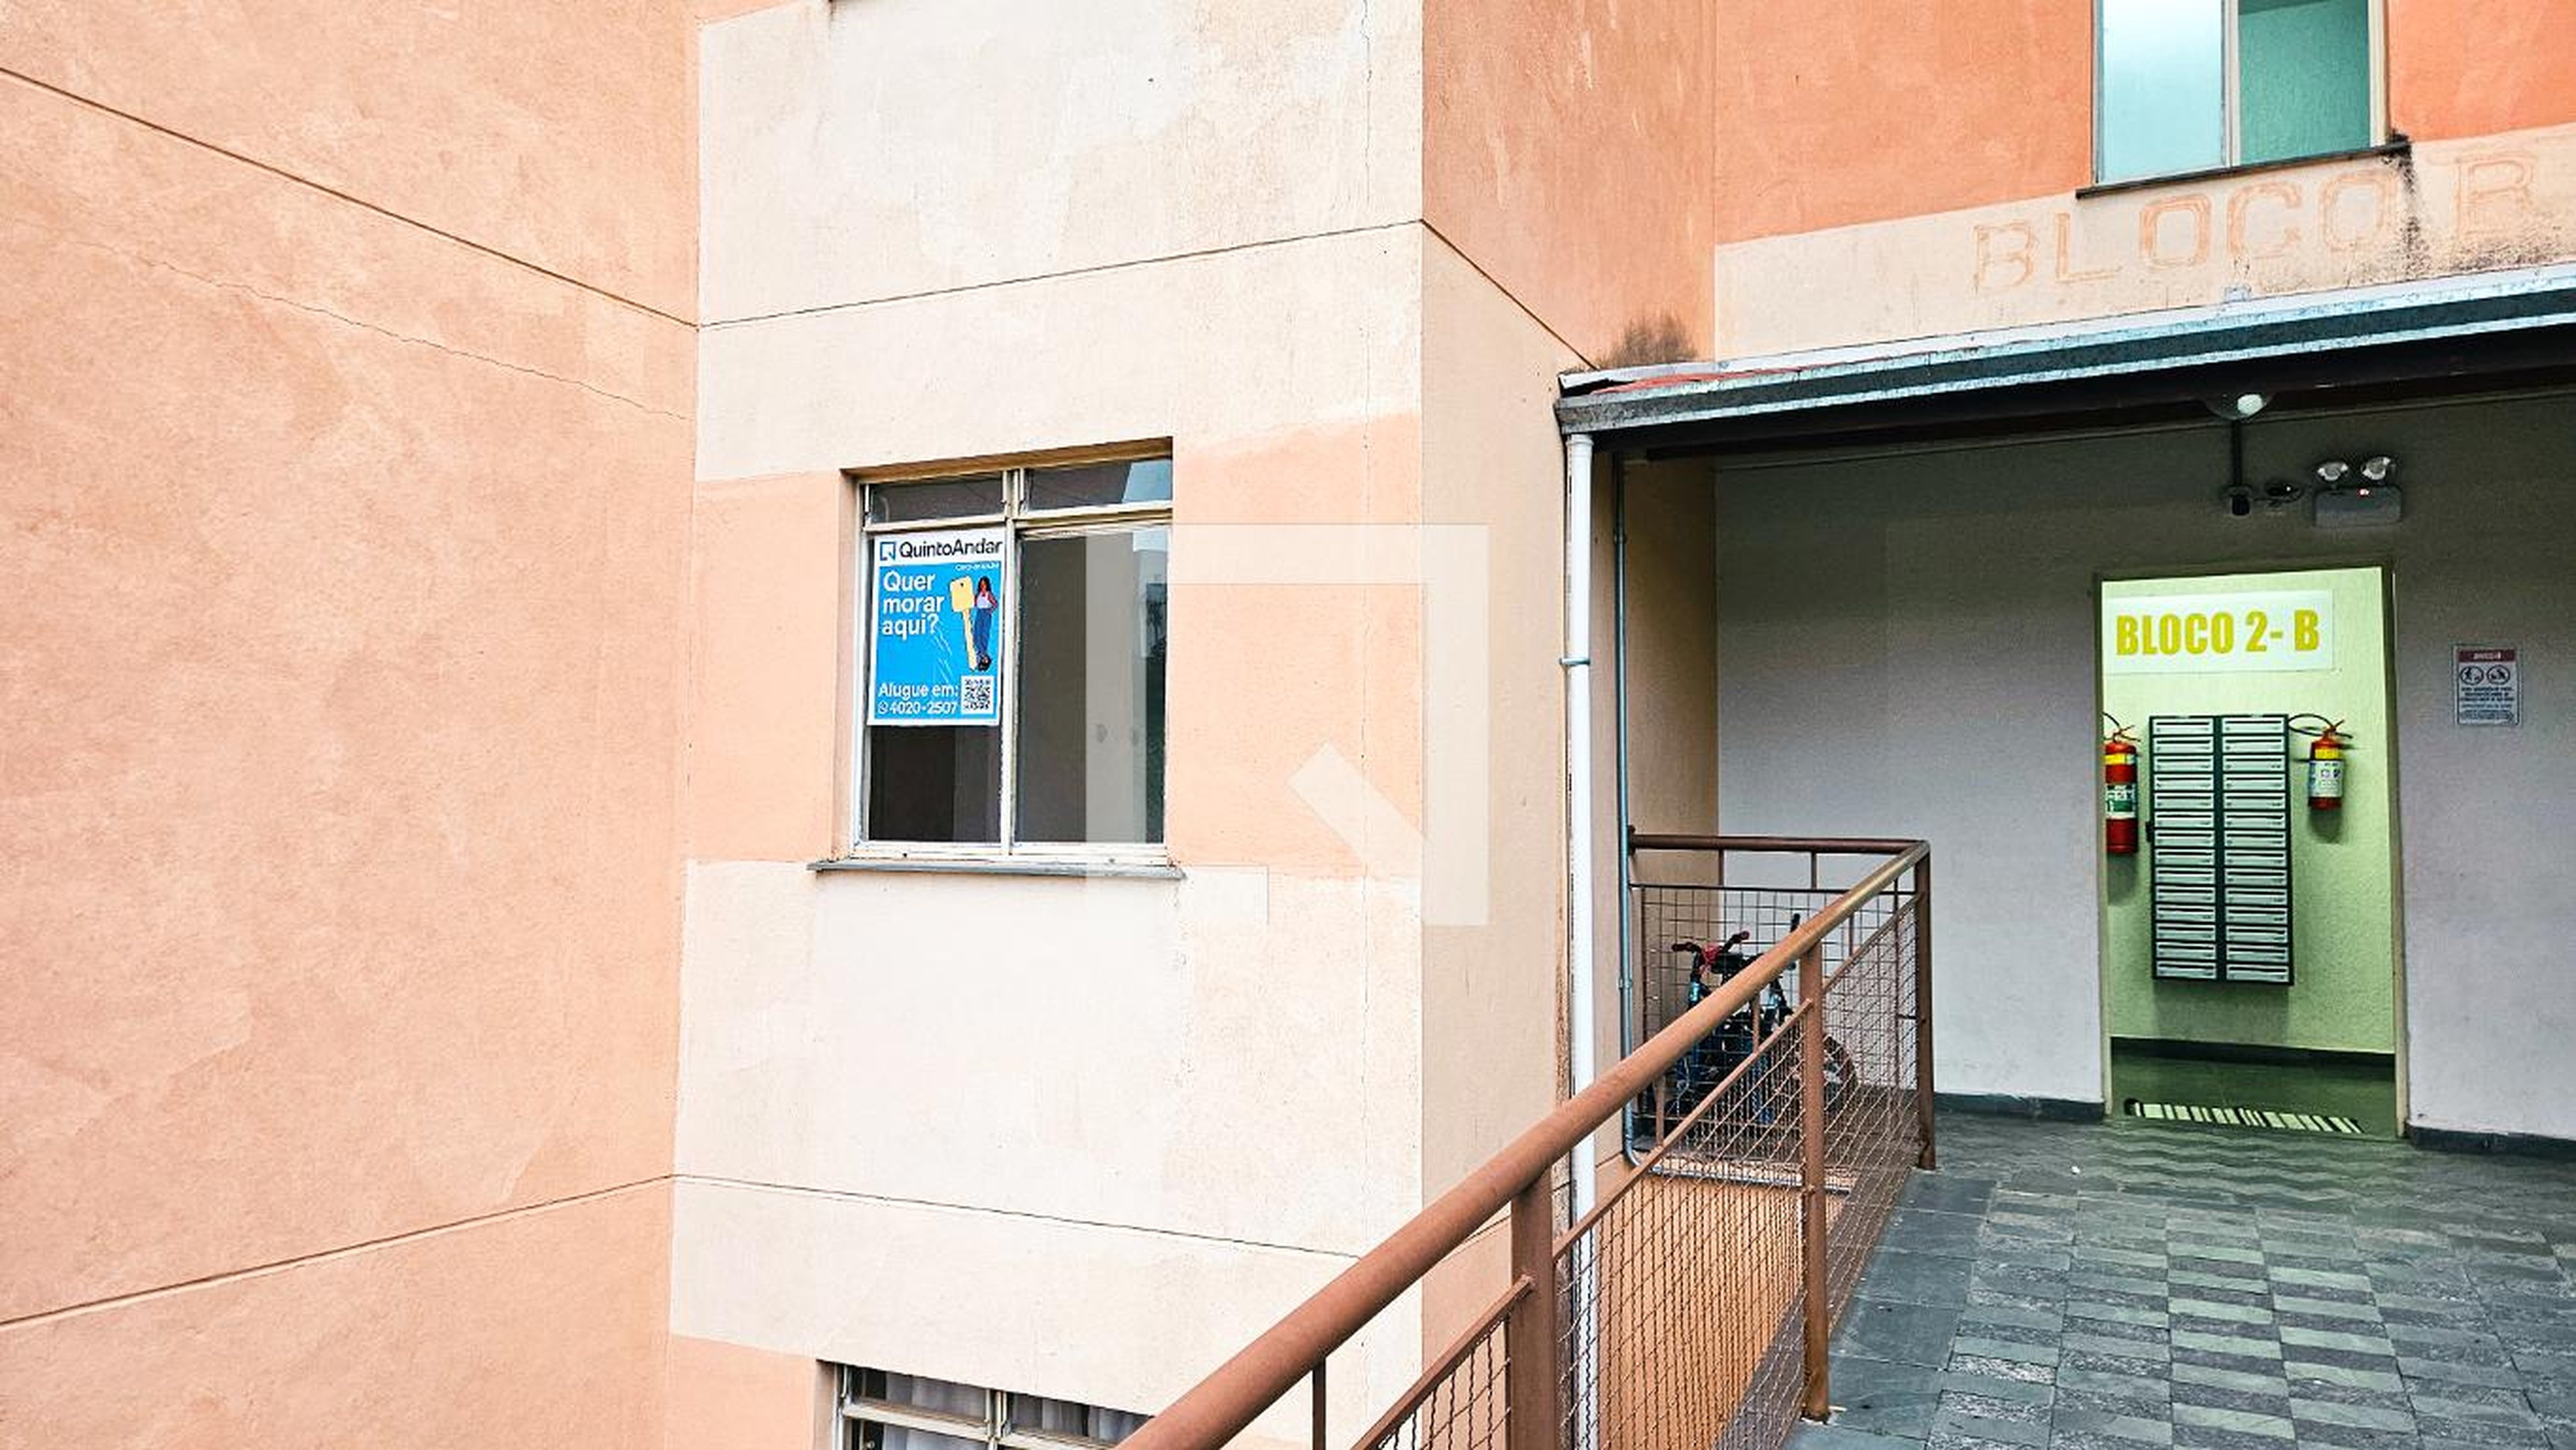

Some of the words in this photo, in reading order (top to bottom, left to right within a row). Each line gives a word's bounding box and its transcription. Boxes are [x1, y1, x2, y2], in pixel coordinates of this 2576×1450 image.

[1973, 170, 2397, 288] BLOCO
[900, 538, 1002, 558] QuintoAndar
[883, 571, 936, 592] Quer
[883, 596, 945, 614] morar
[881, 613, 939, 640] aqui?
[2116, 612, 2234, 655] BLOCO
[2294, 610, 2319, 651] B
[877, 683, 928, 701] Alugue
[932, 684, 959, 697] em:
[890, 701, 957, 714] 4020-2507
